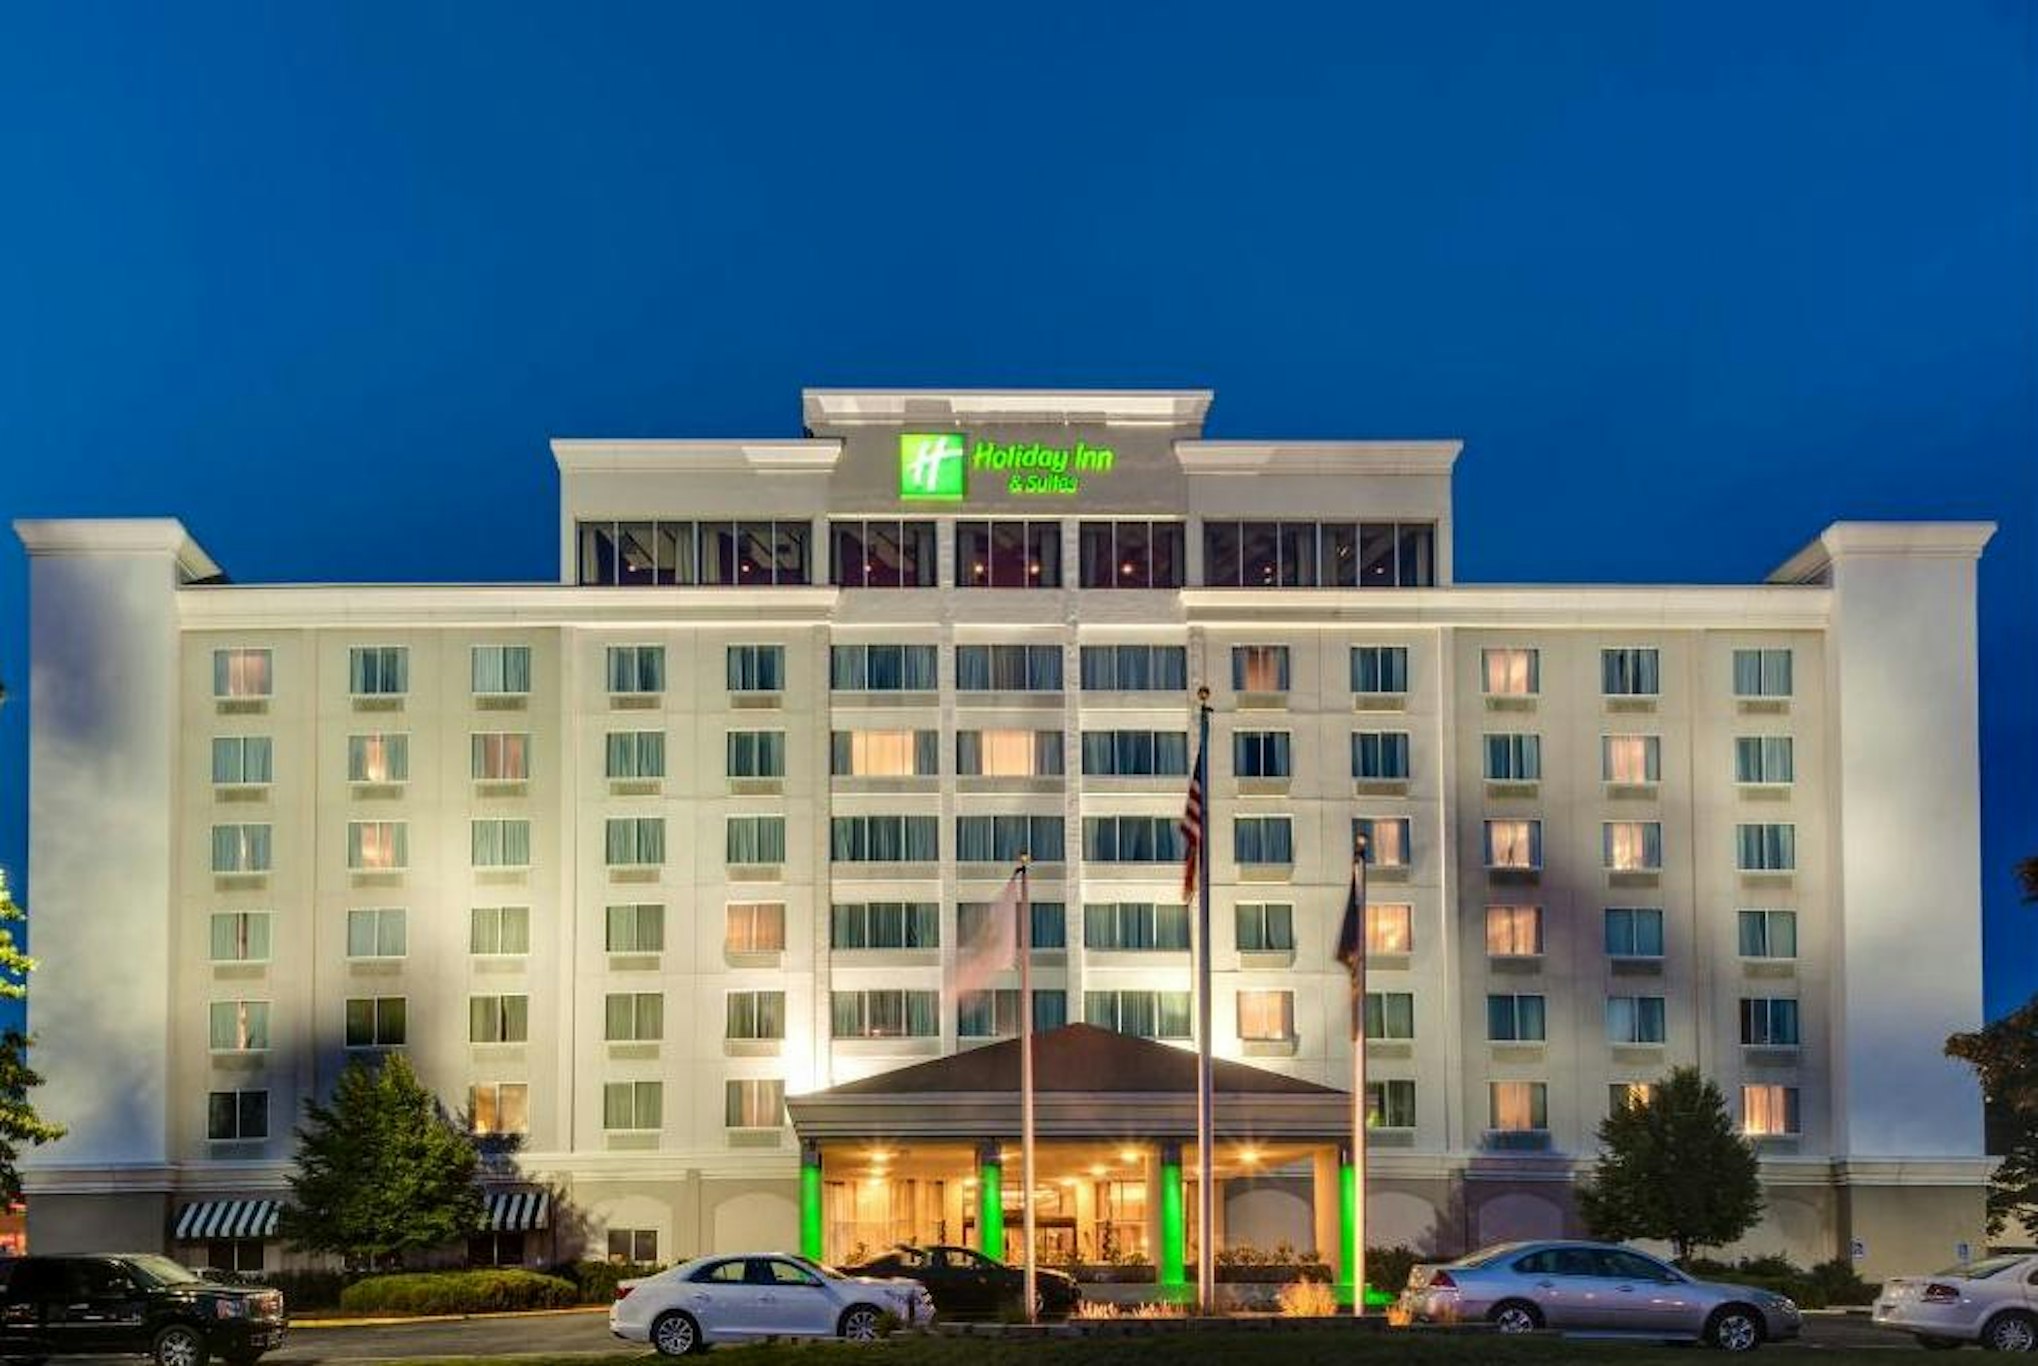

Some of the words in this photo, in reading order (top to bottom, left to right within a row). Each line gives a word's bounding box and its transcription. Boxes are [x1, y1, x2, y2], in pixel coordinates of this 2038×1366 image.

[974, 442, 1068, 472] Holiday
[1074, 443, 1114, 470] Inn
[1009, 476, 1023, 493] &
[1026, 474, 1078, 493] Suites
